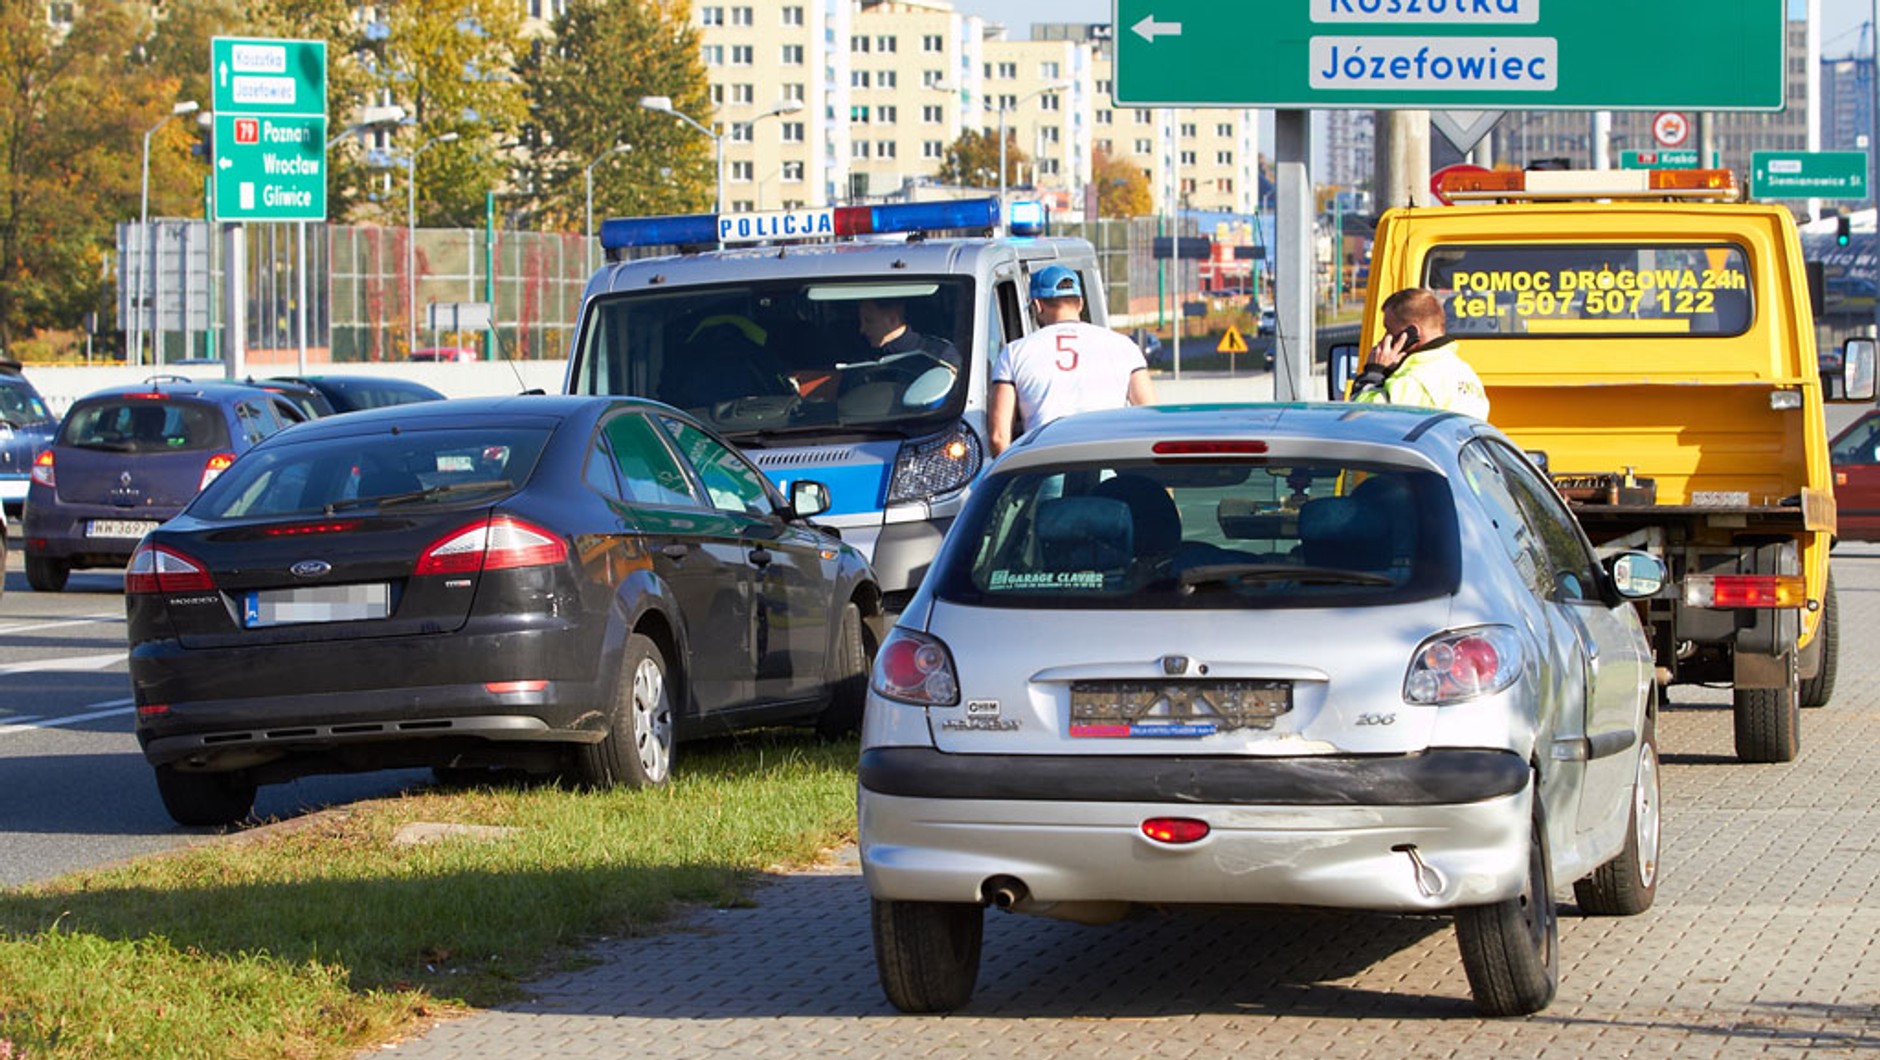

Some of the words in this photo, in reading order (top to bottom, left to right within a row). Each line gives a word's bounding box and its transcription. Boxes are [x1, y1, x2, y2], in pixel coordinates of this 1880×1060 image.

[1321, 45, 1546, 80] Józefowiec
[240, 122, 255, 141] 79
[263, 120, 310, 143] Poznań
[262, 152, 319, 175] Wrocław
[262, 184, 312, 208] Gliwice
[719, 213, 833, 238] POLICJA
[1452, 271, 1552, 292] POMOC
[1559, 269, 1699, 291] DROGOWA
[1701, 269, 1747, 290] 24h
[1452, 293, 1506, 318] tel.
[1516, 290, 1576, 316] 507
[1585, 289, 1645, 315] 507
[1656, 289, 1715, 314] 122
[1055, 335, 1079, 372] 5
[1008, 573, 1054, 583] GARAGE
[1057, 572, 1103, 583] CLAVIER
[1355, 711, 1397, 726] 206
